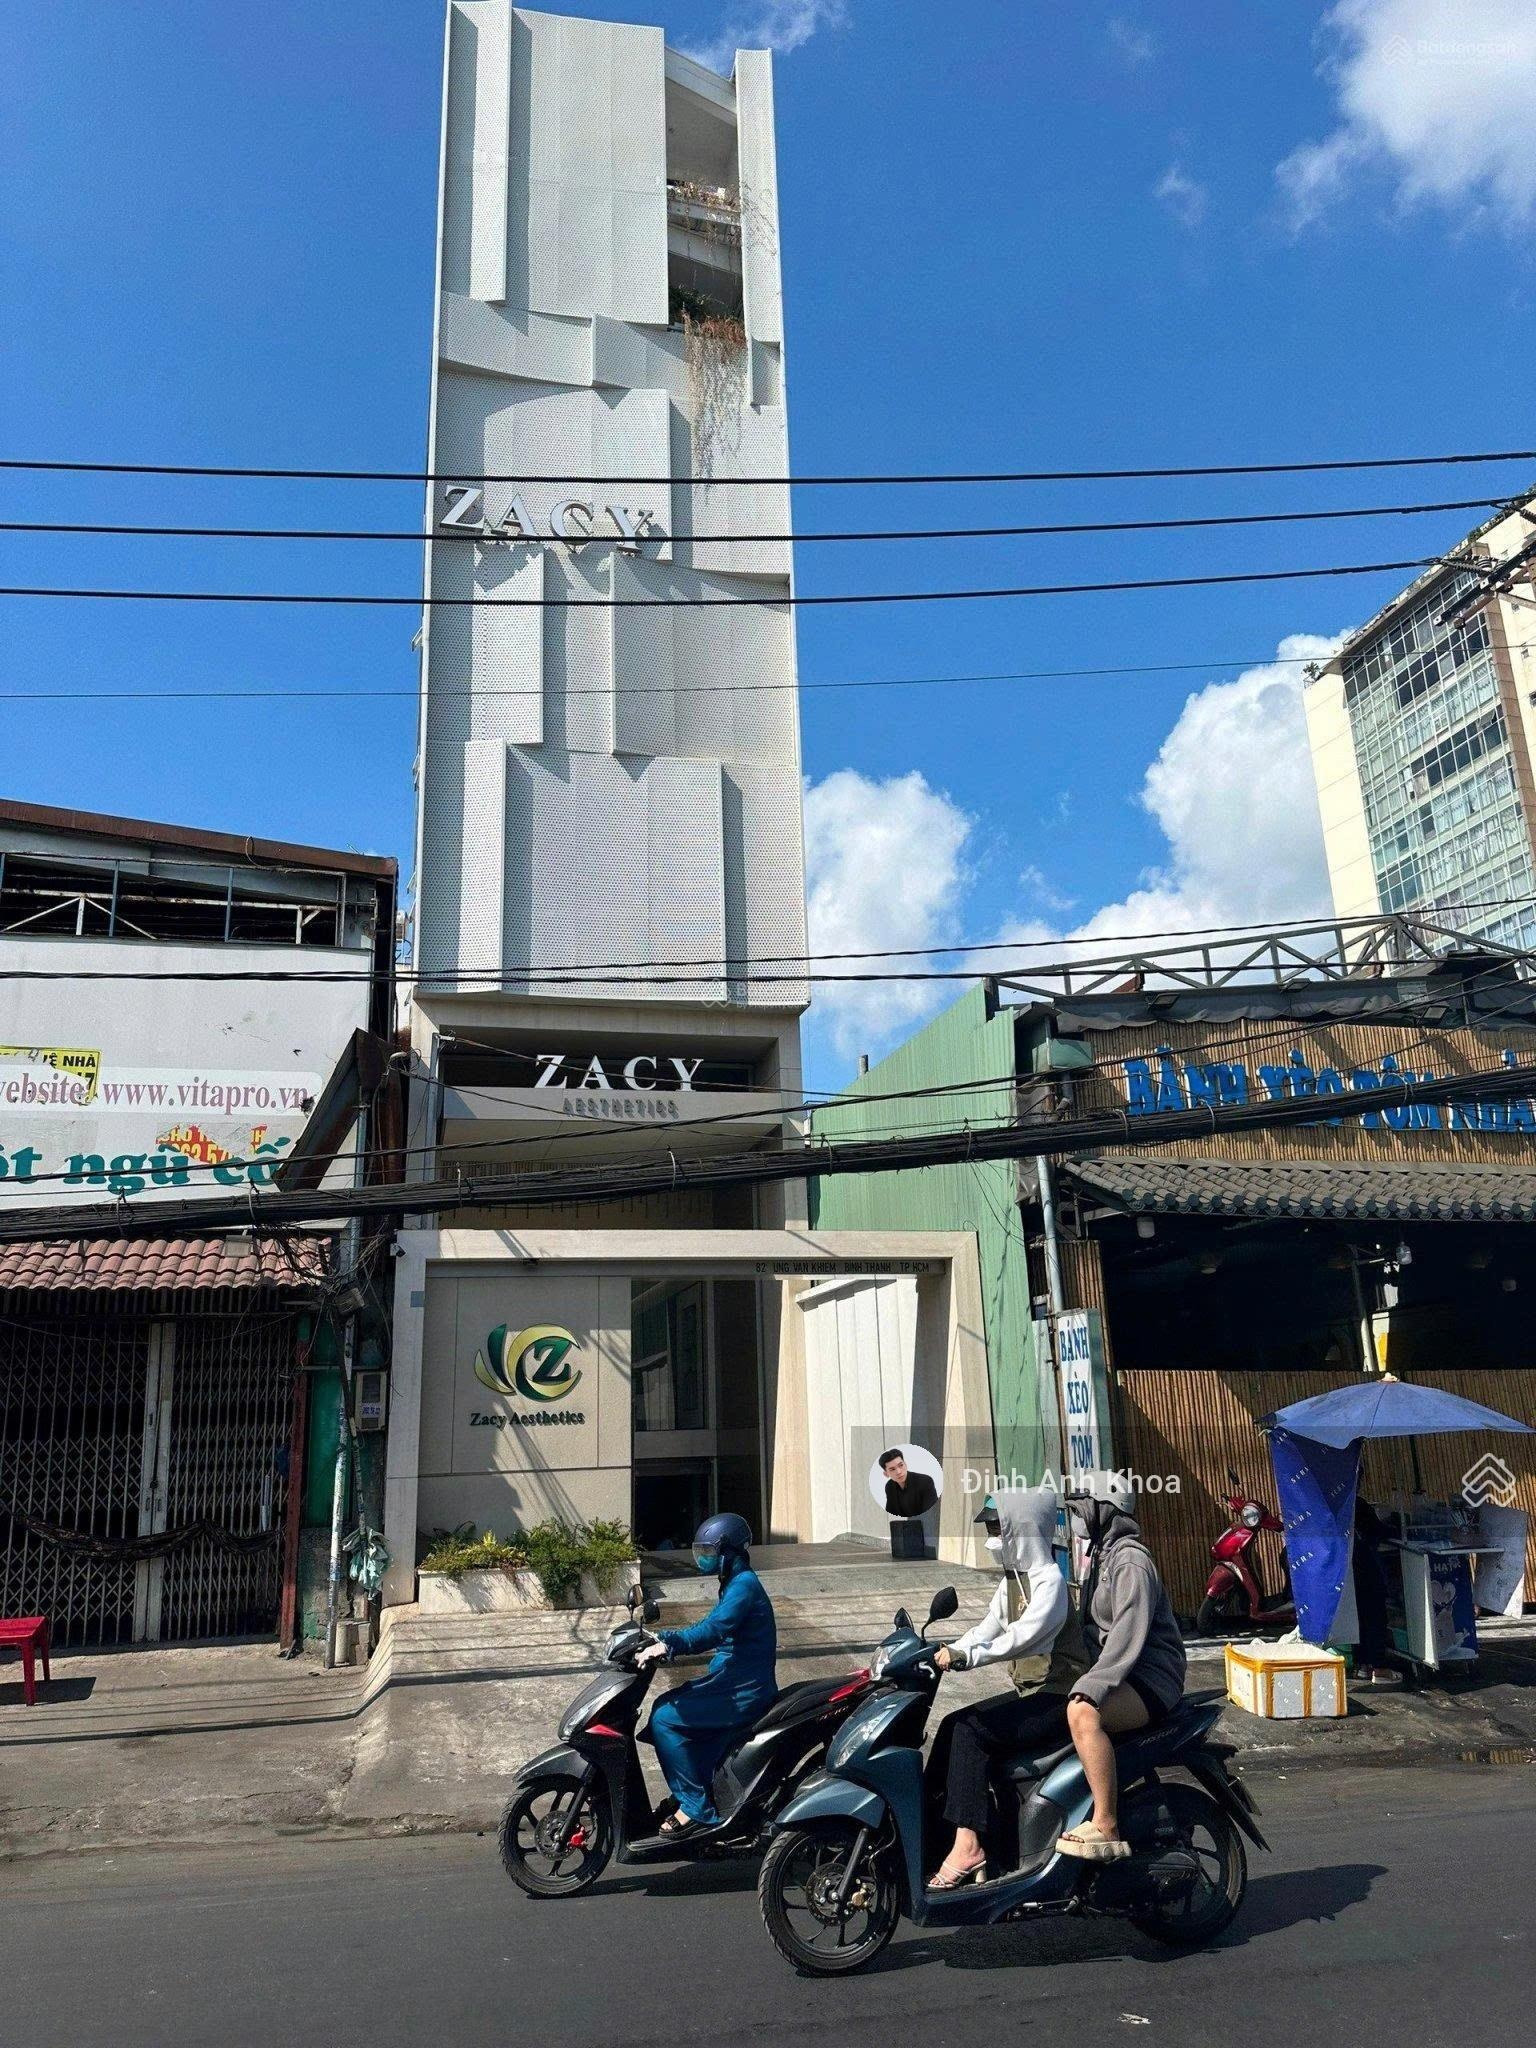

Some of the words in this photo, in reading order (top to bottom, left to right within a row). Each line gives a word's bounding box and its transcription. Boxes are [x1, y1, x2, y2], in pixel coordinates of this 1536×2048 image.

[440, 484, 653, 553] ZACY
[62, 1054, 96, 1068] NHÀ
[532, 1053, 705, 1092] ZACY
[102, 1076, 309, 1116] www.vitapro.vn
[1059, 1320, 1090, 1362] BÁNH
[1067, 1371, 1089, 1415] XÈO
[469, 1413, 507, 1431] Zacy
[509, 1411, 586, 1426] Aesthetics
[1071, 1426, 1095, 1469] TÔM
